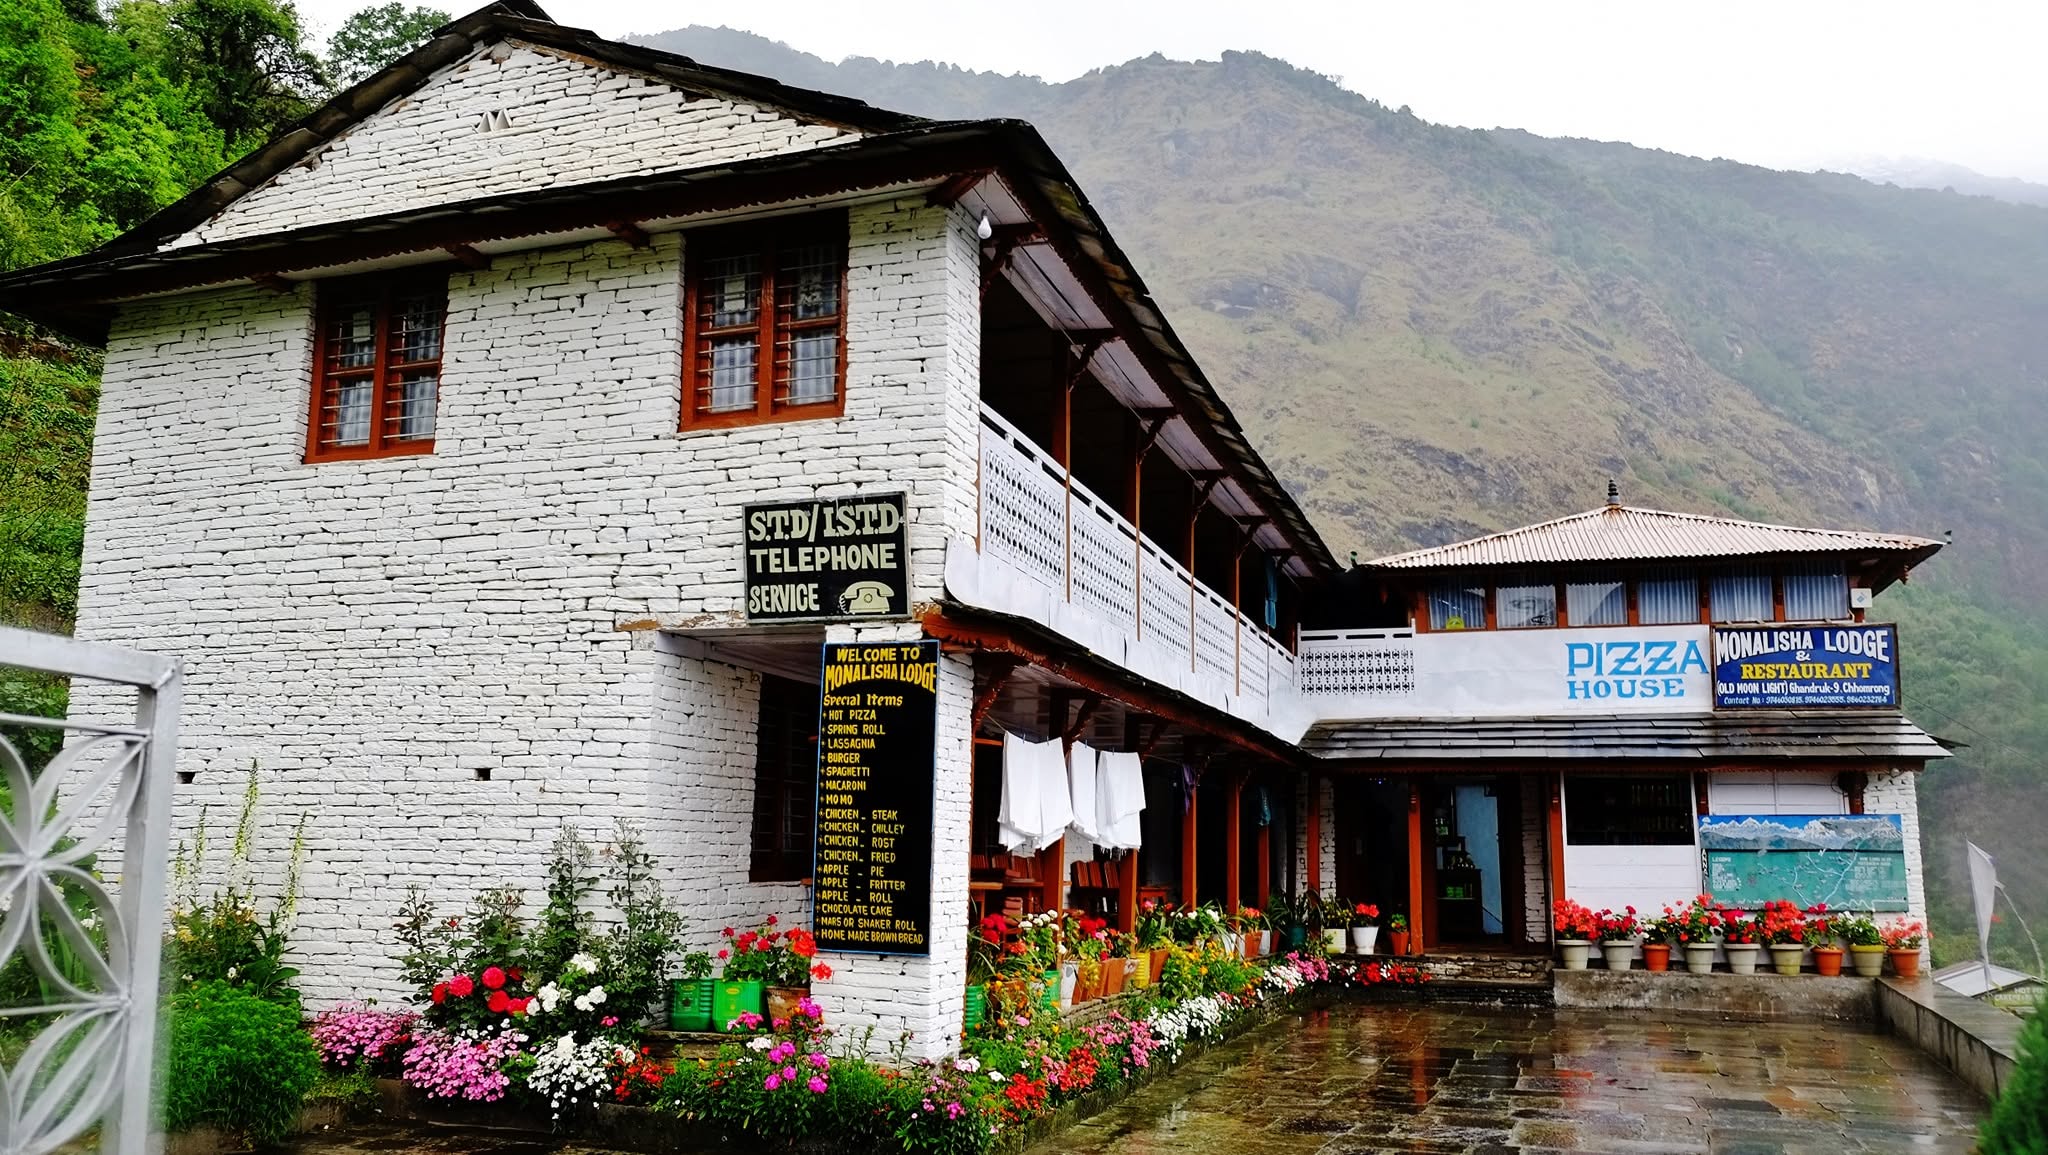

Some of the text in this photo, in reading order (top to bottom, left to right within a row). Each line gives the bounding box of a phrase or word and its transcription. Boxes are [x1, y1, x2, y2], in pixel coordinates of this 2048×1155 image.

[750, 543, 897, 573] TELEPHONE
[750, 583, 820, 613] SERVICE
[837, 647, 920, 662] WELCOME TO
[1716, 630, 1889, 666] MONALISHA LODGE
[1565, 640, 1709, 676] PIZZA
[1795, 650, 1811, 661] &
[1740, 662, 1872, 679] RESTAURANT
[825, 663, 937, 693] MONALISHA LODGE
[1567, 678, 1684, 700] HOUSE
[1717, 681, 1735, 696] (OLD
[1737, 682, 1759, 694] MOON
[1762, 680, 1788, 695] LIGHT)
[823, 694, 903, 707] Special Items
[1724, 696, 1749, 704] Contact
[829, 709, 876, 720] HOT PIZZA
[827, 724, 886, 735] SPRING ROLL
[828, 738, 876, 749] LASSAGNIA
[827, 753, 860, 763] BURGER
[826, 767, 870, 777] SPAGHETTI
[826, 781, 866, 791] MACARONI
[825, 809, 859, 820] CHICKEN
[872, 810, 898, 820] STEAK
[824, 822, 859, 833] CHICKEN
[872, 824, 904, 834] CHILLEY
[824, 835, 859, 846] CHICKEN
[872, 837, 895, 848] ROST
[824, 850, 858, 861] CHICKEN
[871, 852, 896, 863] FRIED
[823, 864, 849, 875] APPLE
[871, 866, 884, 877] PIE
[822, 877, 848, 888] APPLE
[870, 879, 905, 890] FRITTER
[822, 890, 848, 901] APPLE
[870, 892, 893, 903] ROLL
[822, 904, 892, 916] CHOCOLATE CAKE
[821, 917, 916, 931] MARS OR SNAKER ROLL
[821, 929, 923, 944] HOME MADE BROWN BREAD
